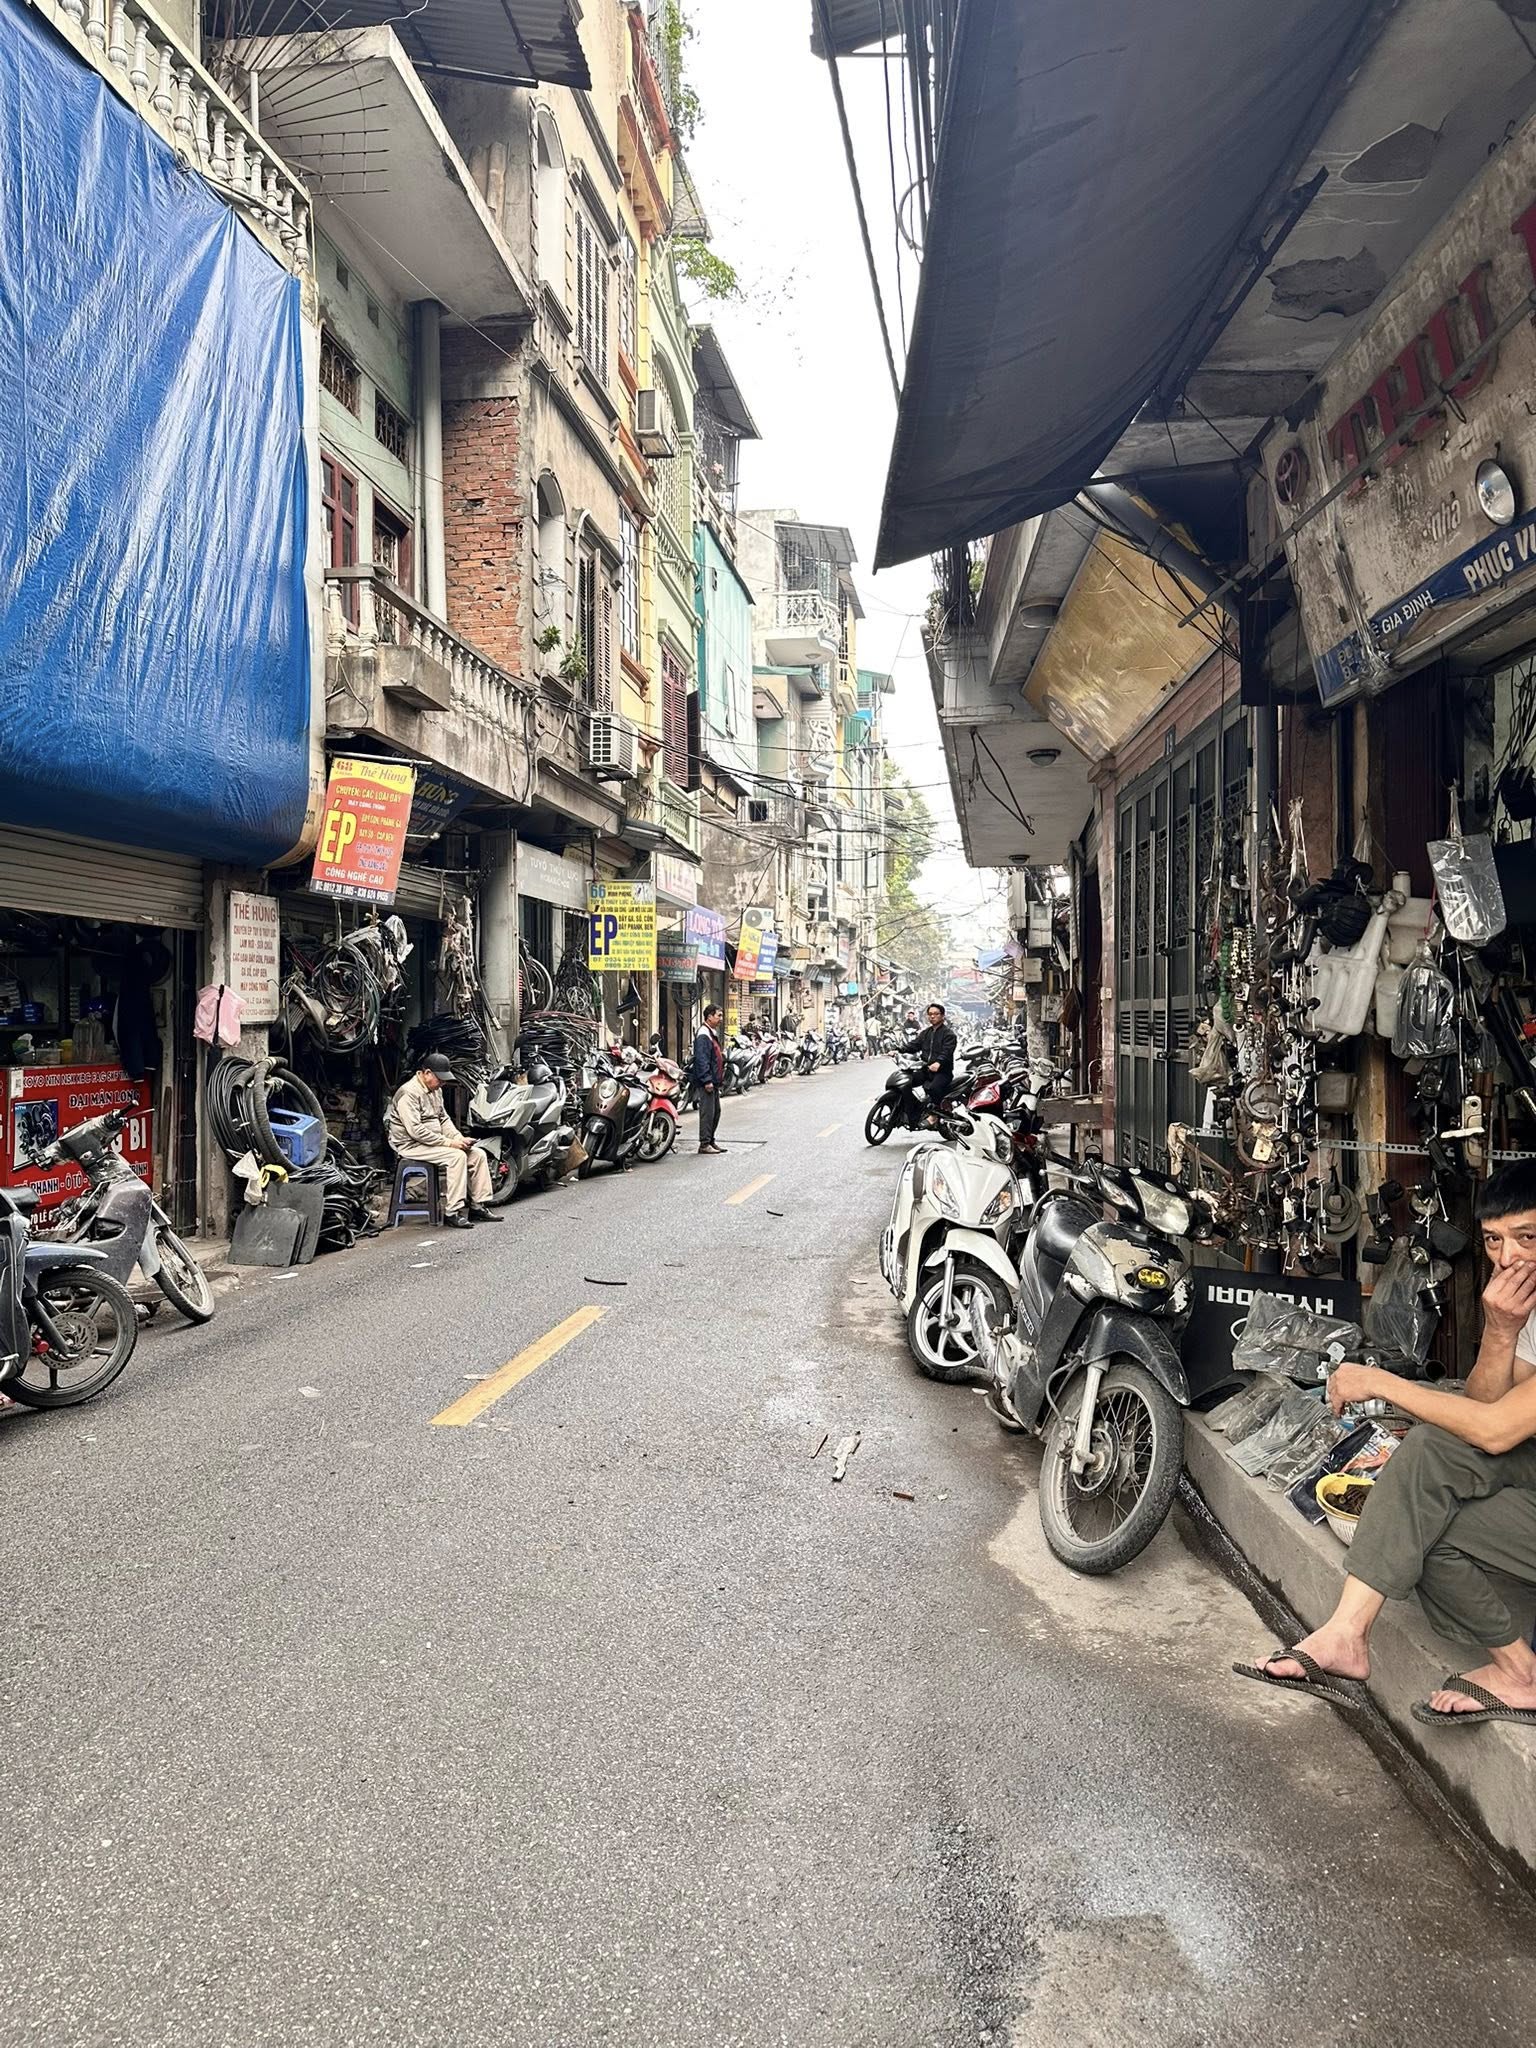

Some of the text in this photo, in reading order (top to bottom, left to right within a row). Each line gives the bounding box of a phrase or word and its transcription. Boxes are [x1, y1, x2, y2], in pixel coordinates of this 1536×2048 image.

[1382, 612, 1403, 634] GIA
[1403, 590, 1435, 619] ĐỊNH
[319, 799, 357, 864] ÉP
[325, 866, 346, 879] CÔNG
[368, 874, 384, 886] CAO
[591, 884, 606, 899] 66
[234, 898, 276, 923] THẾ HÙNG
[590, 904, 617, 956] ÉP
[69, 1093, 89, 1110] ĐẠI
[129, 1117, 147, 1151] BI
[30, 1177, 60, 1196] PHANH
